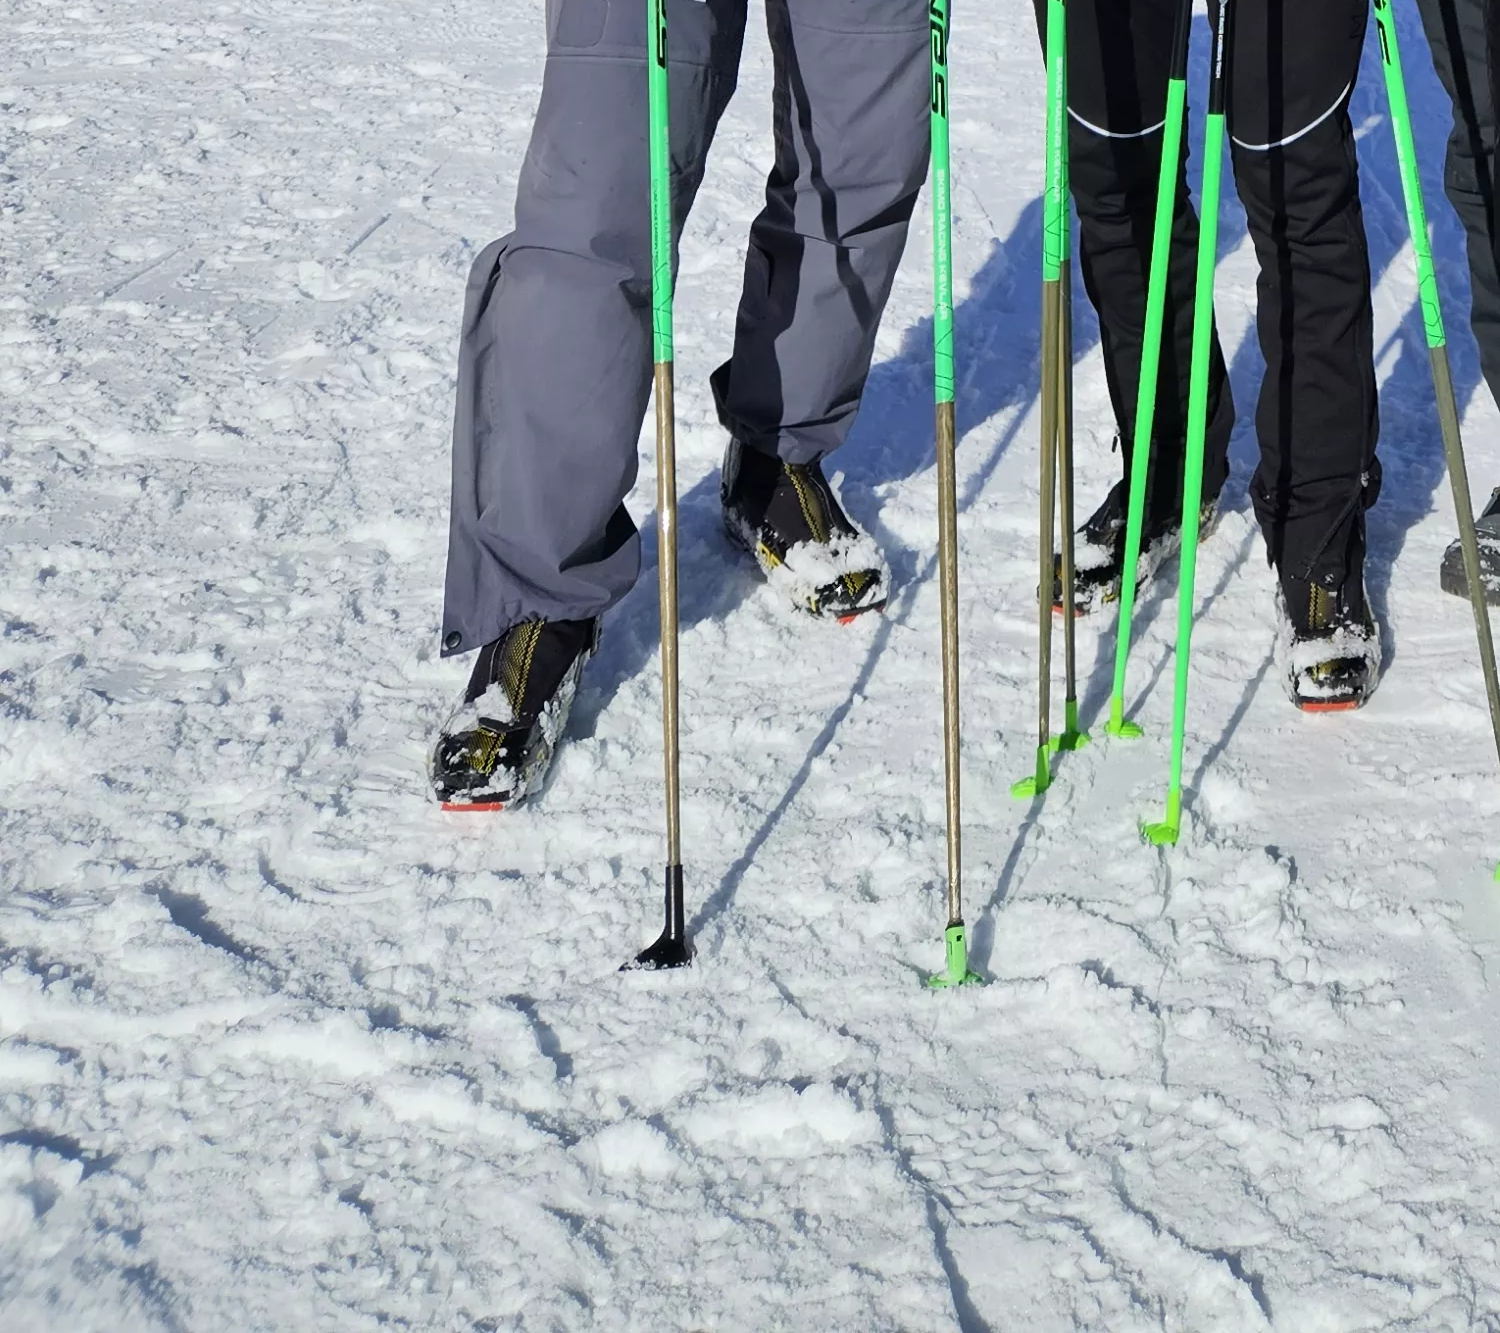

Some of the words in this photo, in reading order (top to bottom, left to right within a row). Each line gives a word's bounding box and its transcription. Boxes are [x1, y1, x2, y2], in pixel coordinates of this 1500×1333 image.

[936, 168, 945, 211] SKIMO
[938, 212, 947, 262] RACING
[939, 264, 949, 321] KEVLAR
